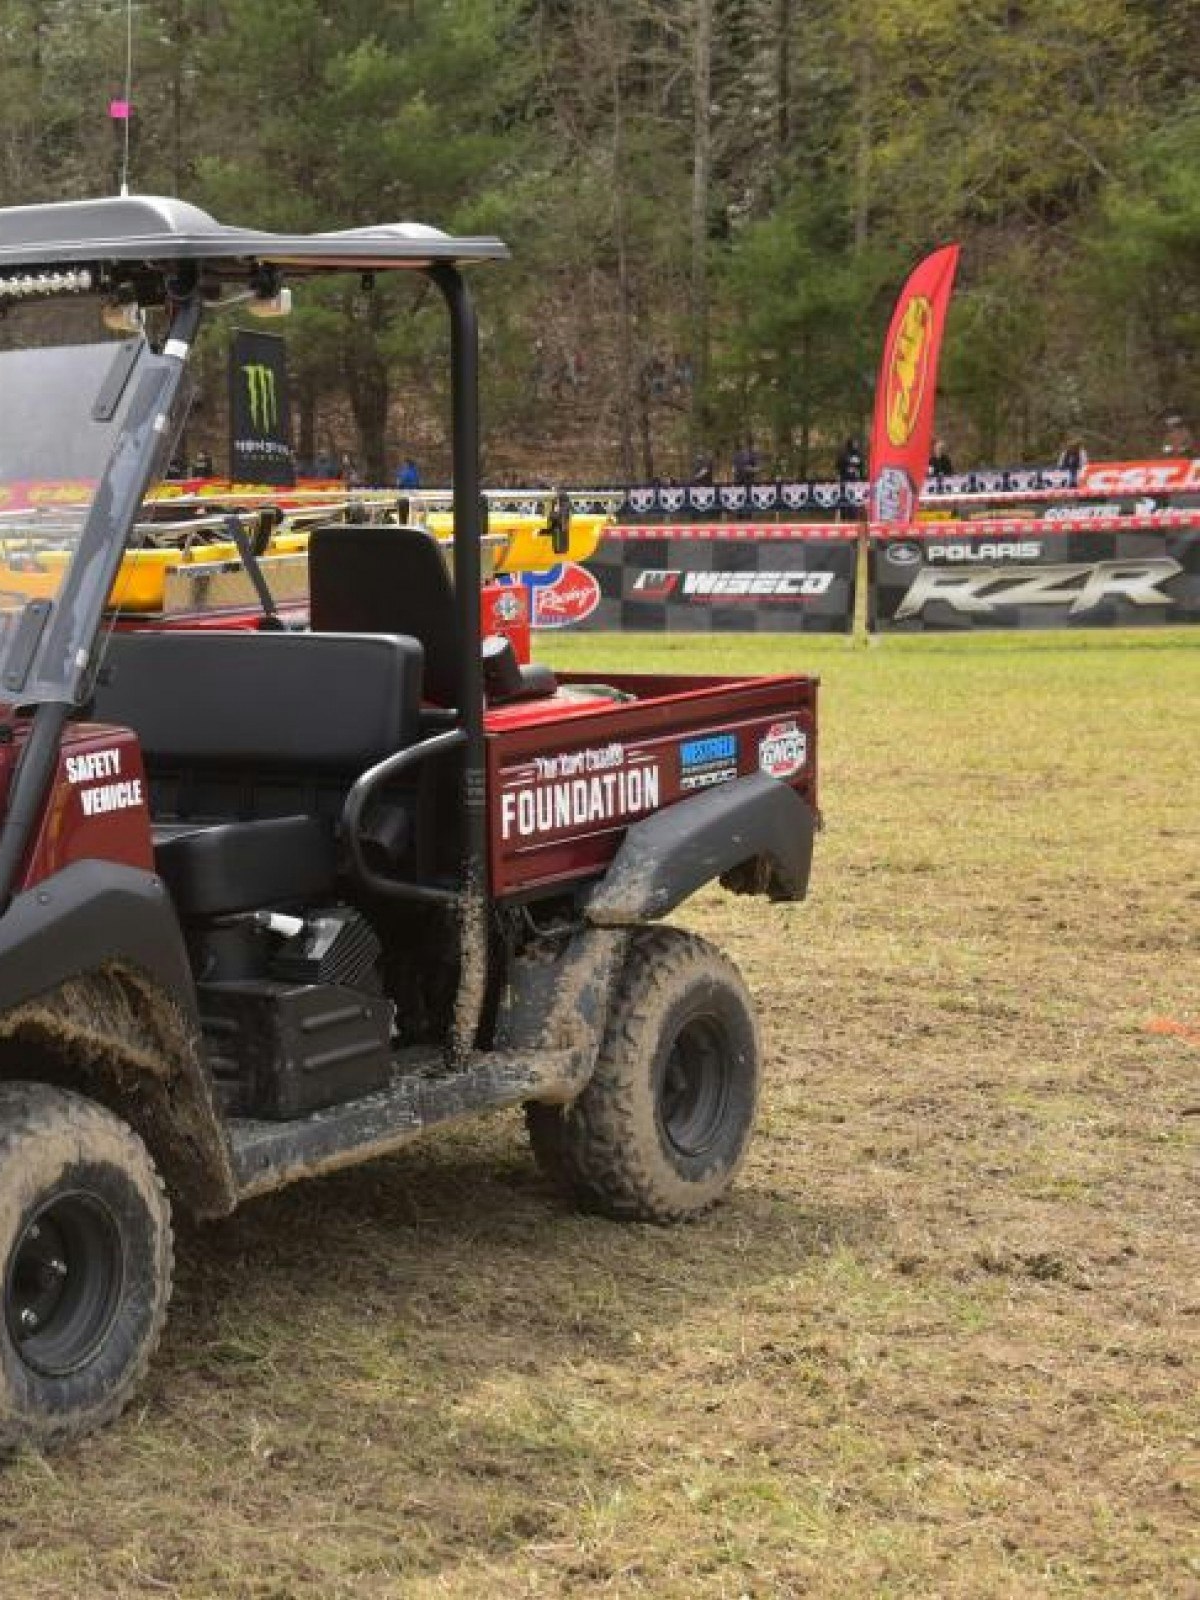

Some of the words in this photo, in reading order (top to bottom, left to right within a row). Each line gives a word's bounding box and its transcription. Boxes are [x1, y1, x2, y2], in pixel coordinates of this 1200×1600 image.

[928, 542, 1041, 561] POLARIS
[893, 556, 1185, 620] RZR
[65, 747, 120, 784] SAFETY
[80, 779, 143, 816] VEHICLE
[501, 765, 660, 841] FOUNDATION
